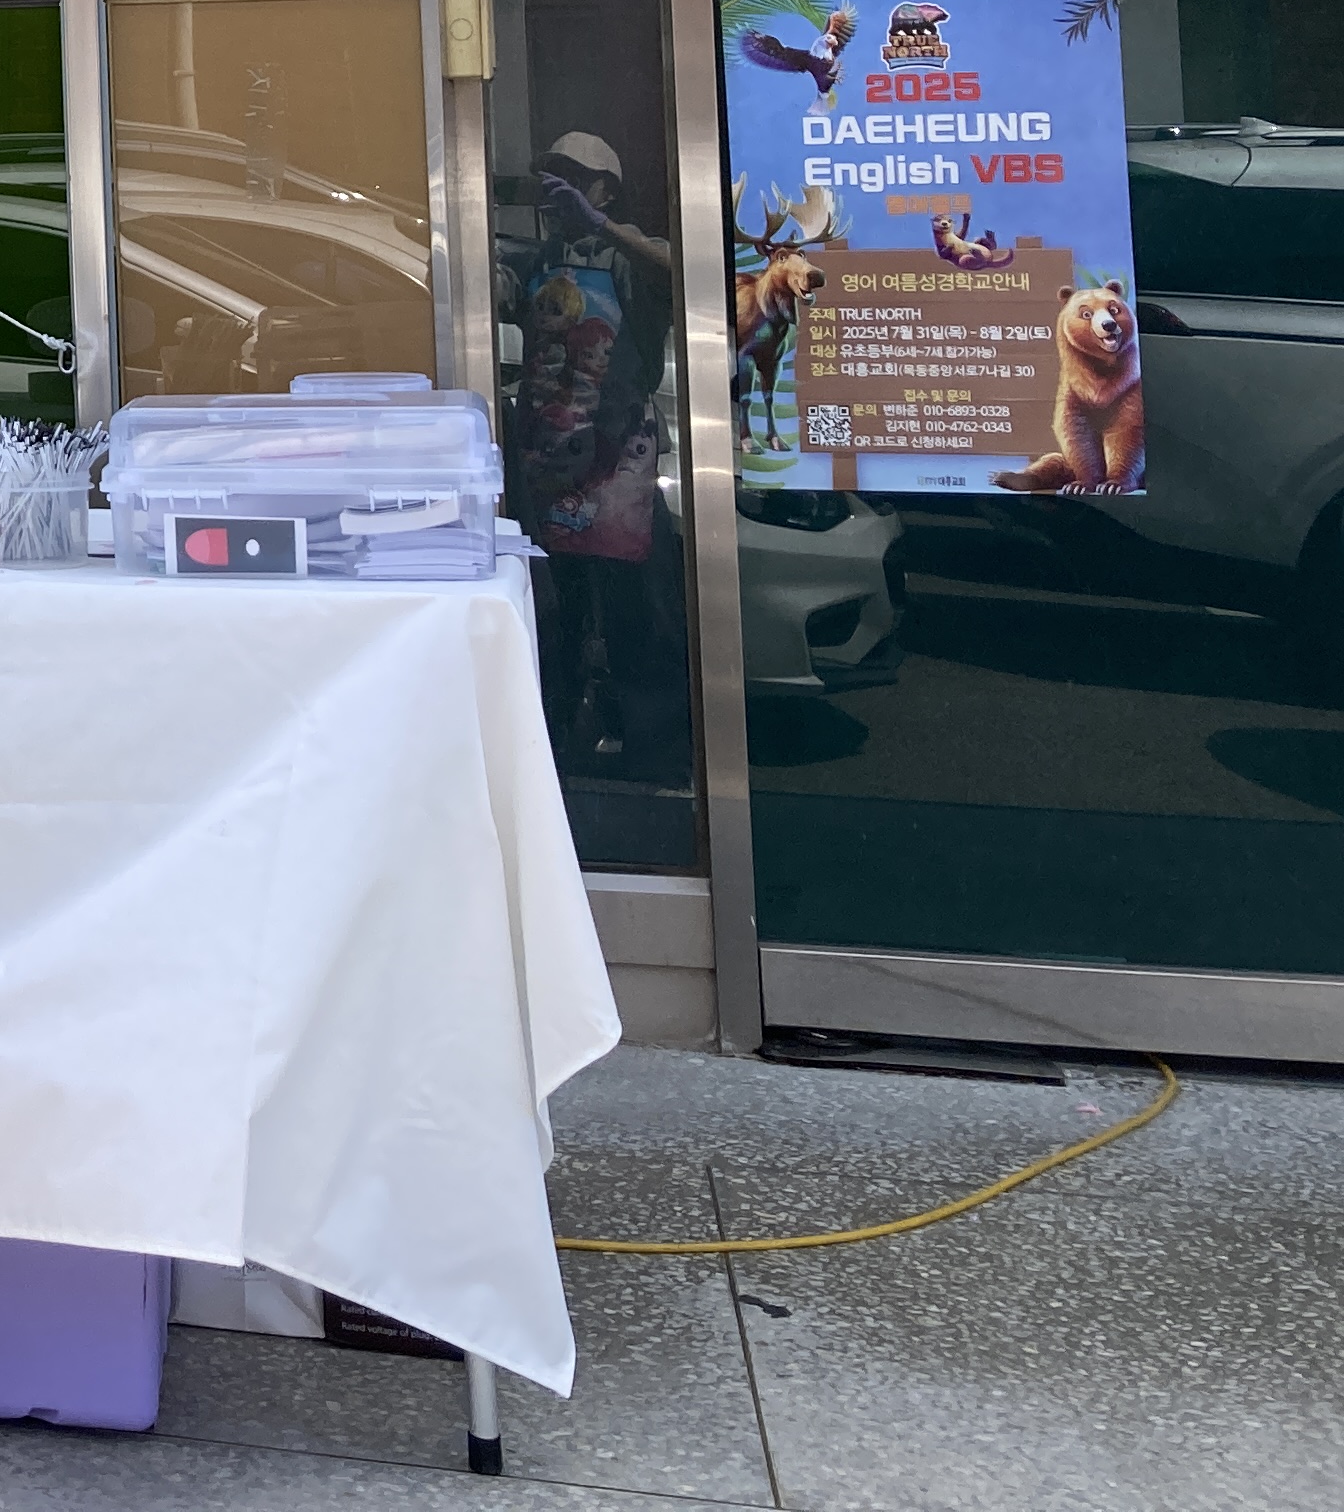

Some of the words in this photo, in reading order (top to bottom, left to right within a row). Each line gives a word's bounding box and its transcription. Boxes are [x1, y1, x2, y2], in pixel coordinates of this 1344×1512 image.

[890, 35, 940, 46] TRUE
[884, 45, 948, 60] NORTH
[865, 72, 981, 103] 2025
[802, 112, 1051, 145] DAEHEUNG
[803, 154, 960, 193] English
[970, 153, 1064, 184] VBS
[841, 274, 877, 292] 영어
[882, 272, 1030, 292] 여름성경학교안내
[809, 308, 836, 322] 주제
[838, 307, 873, 321] TRUE
[876, 307, 921, 321] NORTH
[810, 326, 836, 340] 일시
[842, 326, 888, 340] 2025년
[891, 325, 913, 340] 7월
[916, 325, 967, 340] 31일(목)
[979, 325, 1002, 340] 8월
[1005, 325, 1052, 340] 2일(토)
[810, 344, 836, 358] 대상
[811, 363, 838, 376] 장소
[1015, 365, 1035, 377] 30)
[853, 404, 877, 416] 문의
[923, 405, 1010, 417] 010-6893-0328
[926, 421, 1012, 433] 010-4762-0343
[854, 436, 871, 447] QR
